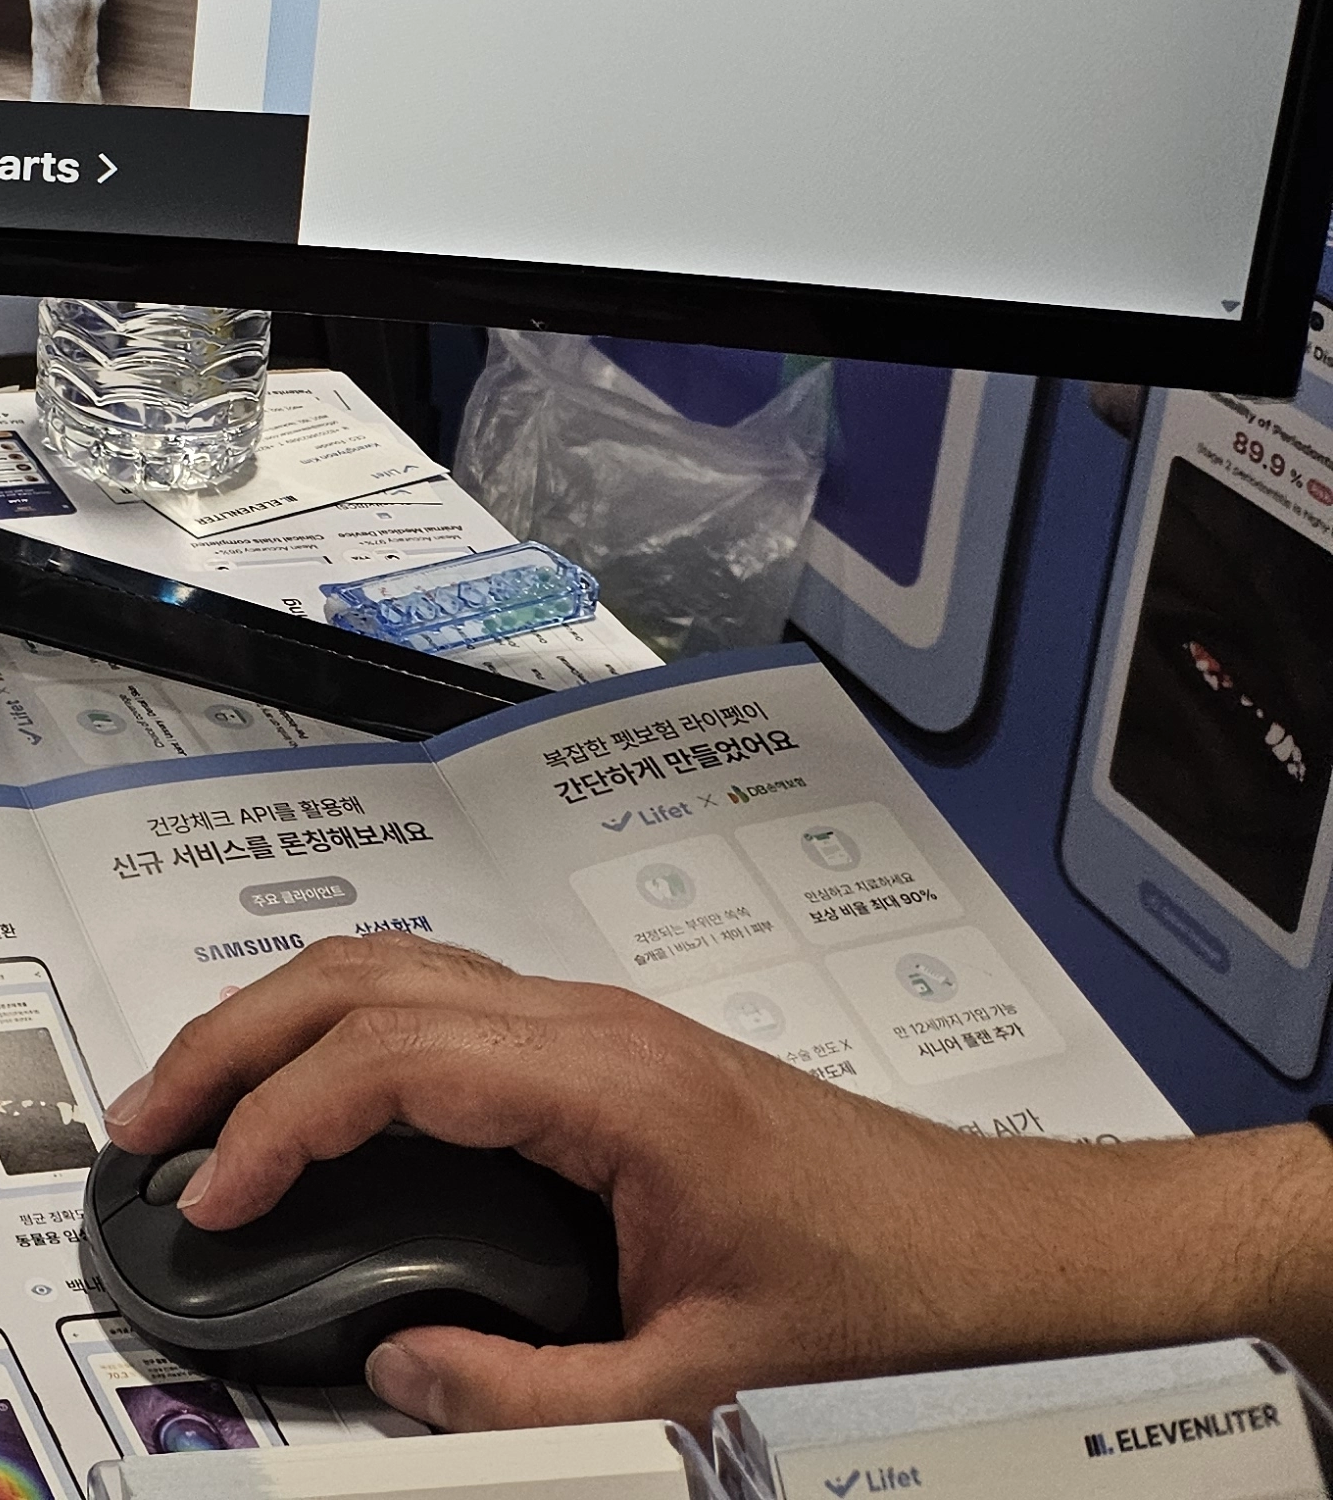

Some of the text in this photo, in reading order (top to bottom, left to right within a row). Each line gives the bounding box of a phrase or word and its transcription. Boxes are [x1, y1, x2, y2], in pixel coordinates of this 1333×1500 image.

[1233, 431, 1303, 489] 89.9 %
[195, 497, 283, 526] ELEVENLITER
[6, 699, 33, 727] Lifet
[542, 701, 769, 769] 복잡한 펫보험 라이펫이
[553, 729, 801, 805] 간단하게 만들었어요
[146, 794, 366, 838] 건강체크 API를 활용해
[637, 801, 693, 827] Lifet
[112, 821, 434, 881] 신규 서비스를 론칭해보세요
[251, 884, 346, 908] 주요 클라이언트
[803, 871, 916, 904] 안심하고 치료하세요
[808, 887, 938, 926] 보상 비율 최대 90%
[634, 912, 723, 946] 걱정되는 부위만
[193, 933, 305, 963] SAMSUNG
[633, 936, 710, 967] 슬개골 비뇨기
[963, 1006, 991, 1027] 가입
[990, 1001, 1019, 1018] 기능
[812, 1040, 842, 1058] 한도
[917, 1022, 1026, 1058] 시니어 플랜 추가
[18, 1211, 47, 1227] 평균
[15, 1230, 61, 1248] 동물용
[864, 1402, 1283, 1494] Lifet ELEVENLITER
